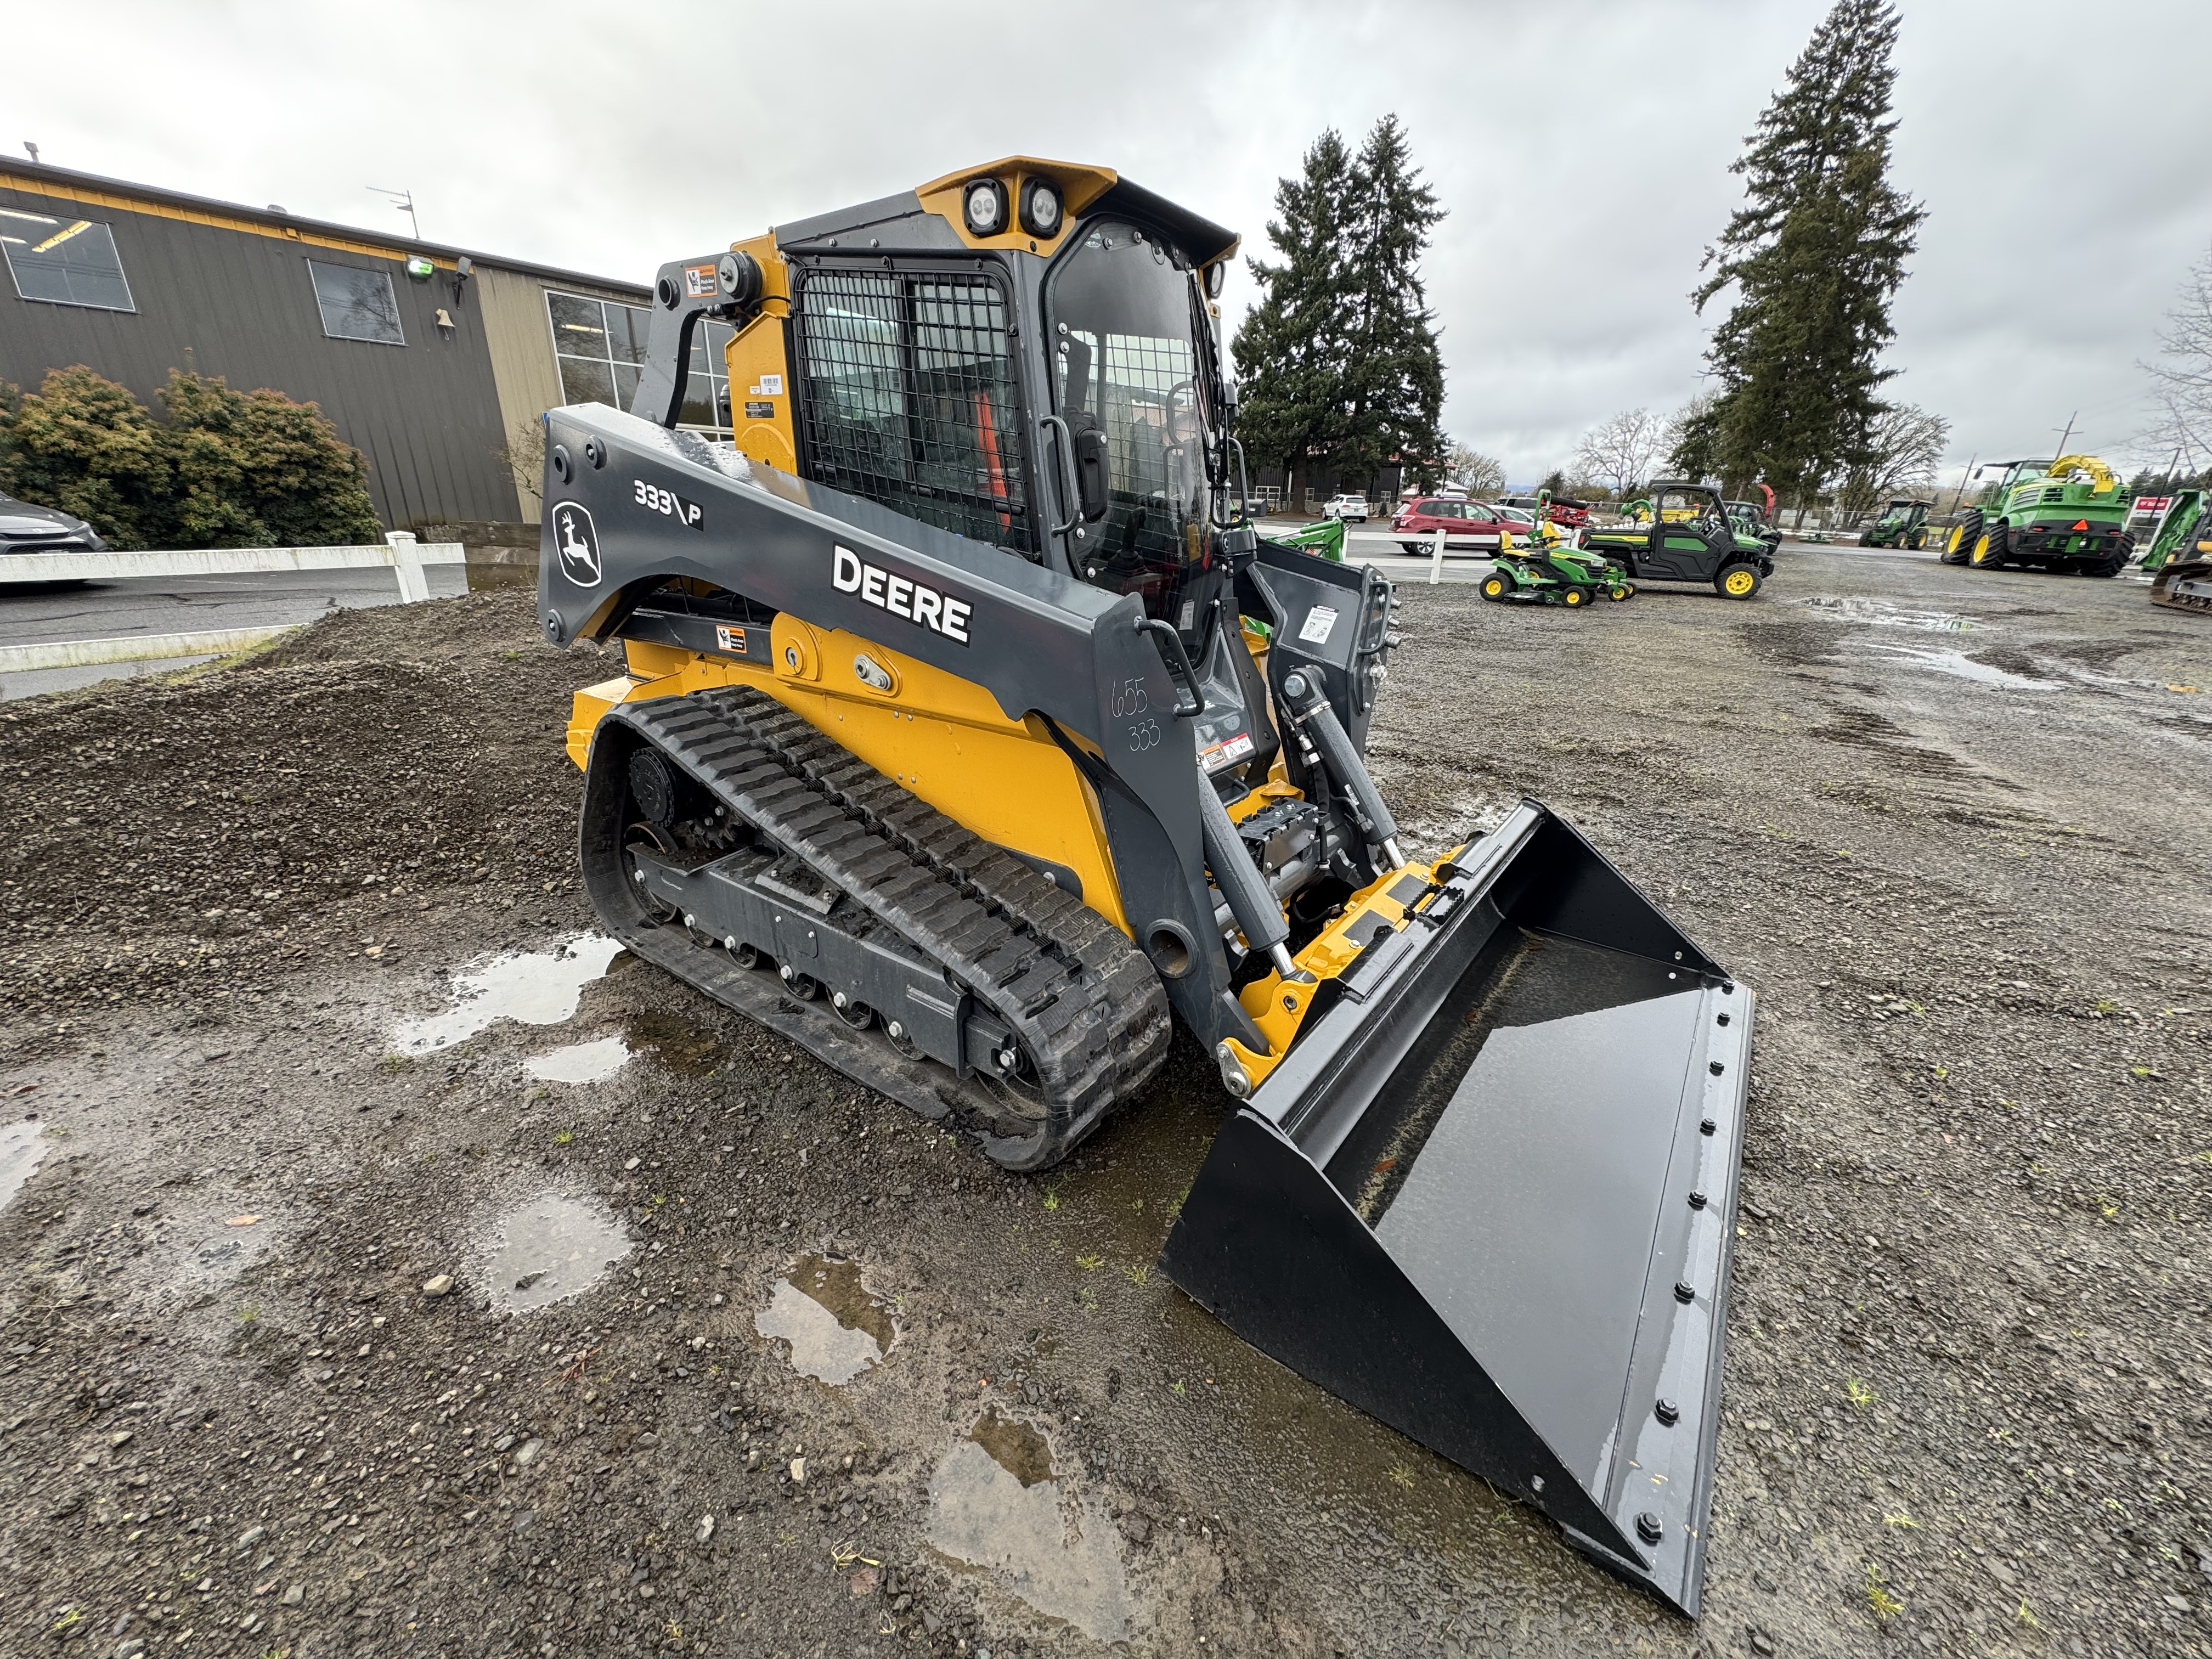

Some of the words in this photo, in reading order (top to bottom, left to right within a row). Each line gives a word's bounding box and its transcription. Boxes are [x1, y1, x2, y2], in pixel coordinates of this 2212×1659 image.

[833, 545, 971, 642] DEERE
[1111, 677, 1148, 718] 655
[1128, 719, 1161, 752] 333
